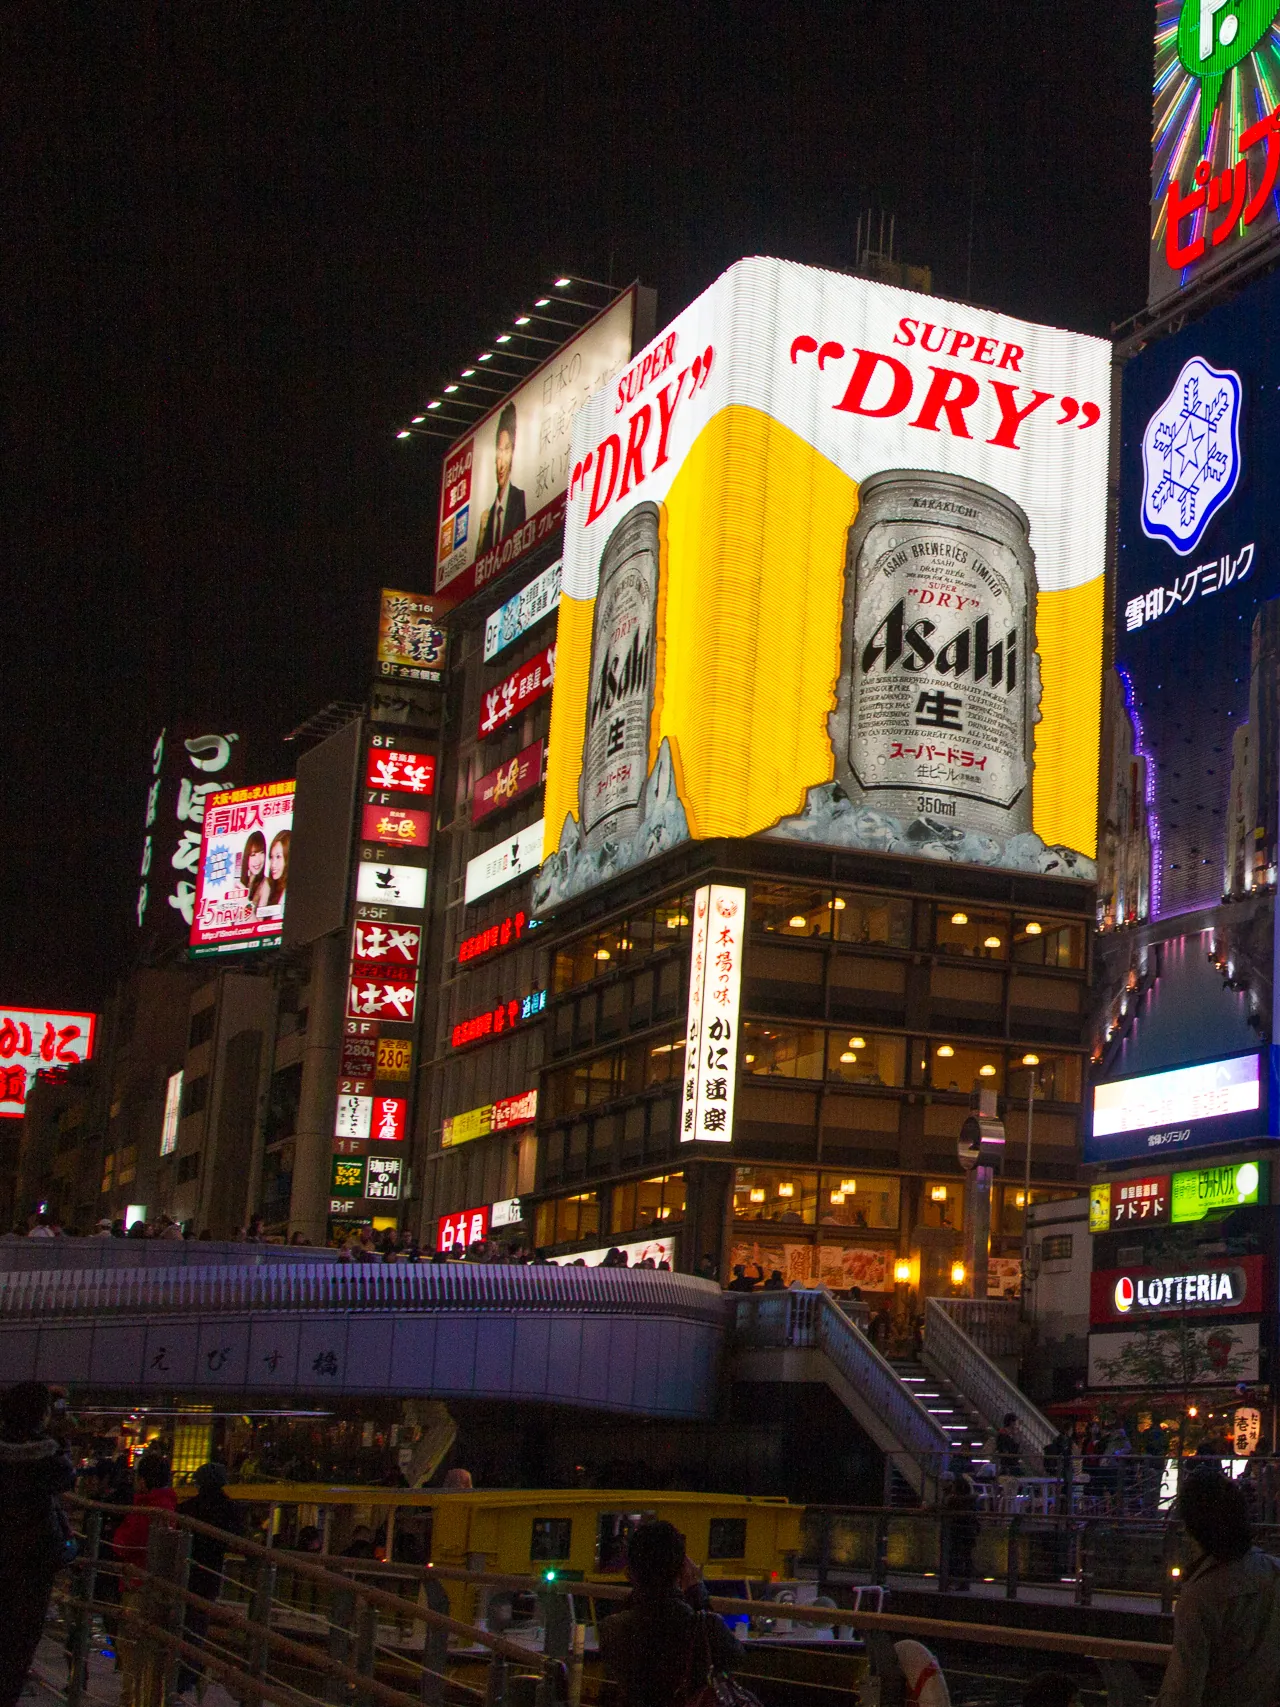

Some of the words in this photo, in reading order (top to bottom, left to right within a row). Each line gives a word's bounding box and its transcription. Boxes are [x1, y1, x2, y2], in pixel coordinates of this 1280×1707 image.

[892, 317, 1024, 372] SUPER
[615, 331, 676, 415] SUPER
[882, 551, 909, 578] ASAHI
[911, 542, 969, 564] BREWERIES
[971, 559, 1003, 598] LIMITED
[931, 558, 955, 568] ASAHI
[945, 568, 966, 579] BEER
[928, 581, 957, 592] SUPER
[1125, 543, 1254, 632] 雪印メグミルク
[862, 596, 1017, 696] Asahi
[381, 662, 399, 675] 9F
[914, 690, 963, 730] 生
[372, 735, 395, 748] 8F
[921, 730, 946, 739] GREAT
[949, 733, 970, 744] TASTE
[889, 742, 987, 771] スーパードライ
[917, 764, 959, 781] 生ビール
[368, 791, 390, 804] 7F
[917, 796, 957, 817] 350ml
[214, 804, 264, 836] 高収入
[363, 848, 385, 860] 6F
[356, 926, 419, 961] はや
[351, 982, 414, 1017] はや
[347, 1022, 370, 1034] 3F
[341, 1081, 365, 1093] 2F
[379, 1098, 399, 1139] 白木屋
[338, 1140, 359, 1151] 1F
[369, 1160, 399, 1173] 珈琲
[380, 1173, 389, 1182] の
[368, 1182, 397, 1197] 青山
[331, 1200, 354, 1212] B1F
[1115, 1197, 1164, 1221] アドアド
[1137, 1273, 1233, 1306] LOTTERIA
[149, 1347, 337, 1376] えびす橋
